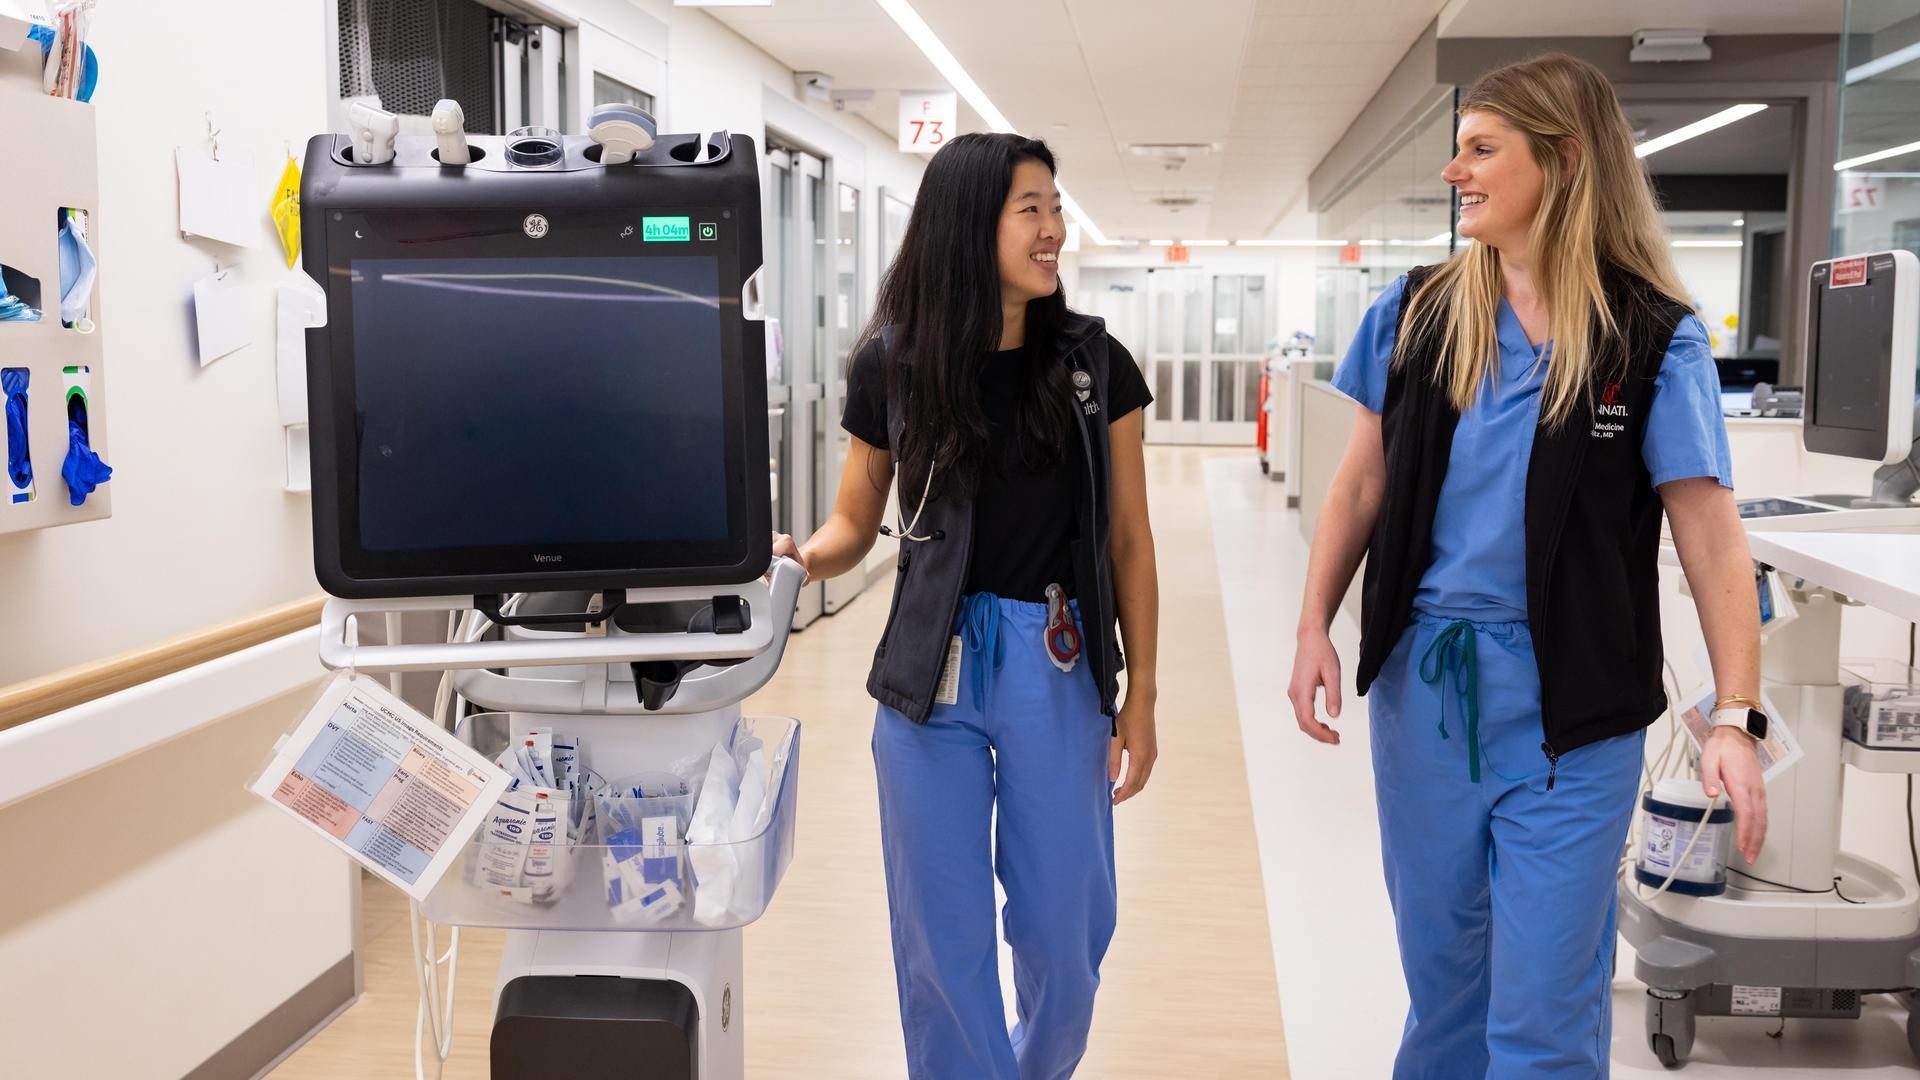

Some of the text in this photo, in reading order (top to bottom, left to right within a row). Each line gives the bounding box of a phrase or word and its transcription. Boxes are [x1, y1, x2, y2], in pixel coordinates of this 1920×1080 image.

[923, 101, 930, 112] F
[910, 121, 943, 144] 73
[645, 224, 689, 236] 4h 04m
[1594, 422, 1624, 432] Medicine
[534, 554, 562, 562] Venue
[342, 701, 358, 714] Aorta
[327, 722, 339, 732] DVT
[379, 706, 395, 718] UCMC
[400, 720, 414, 732] Image
[413, 729, 444, 751] Requirements
[412, 748, 426, 759] Biliary
[290, 770, 304, 781] Echo
[392, 773, 404, 783] Preg
[396, 768, 409, 778] Early
[361, 815, 373, 825] FAST
[493, 816, 527, 827] Aquasonic
